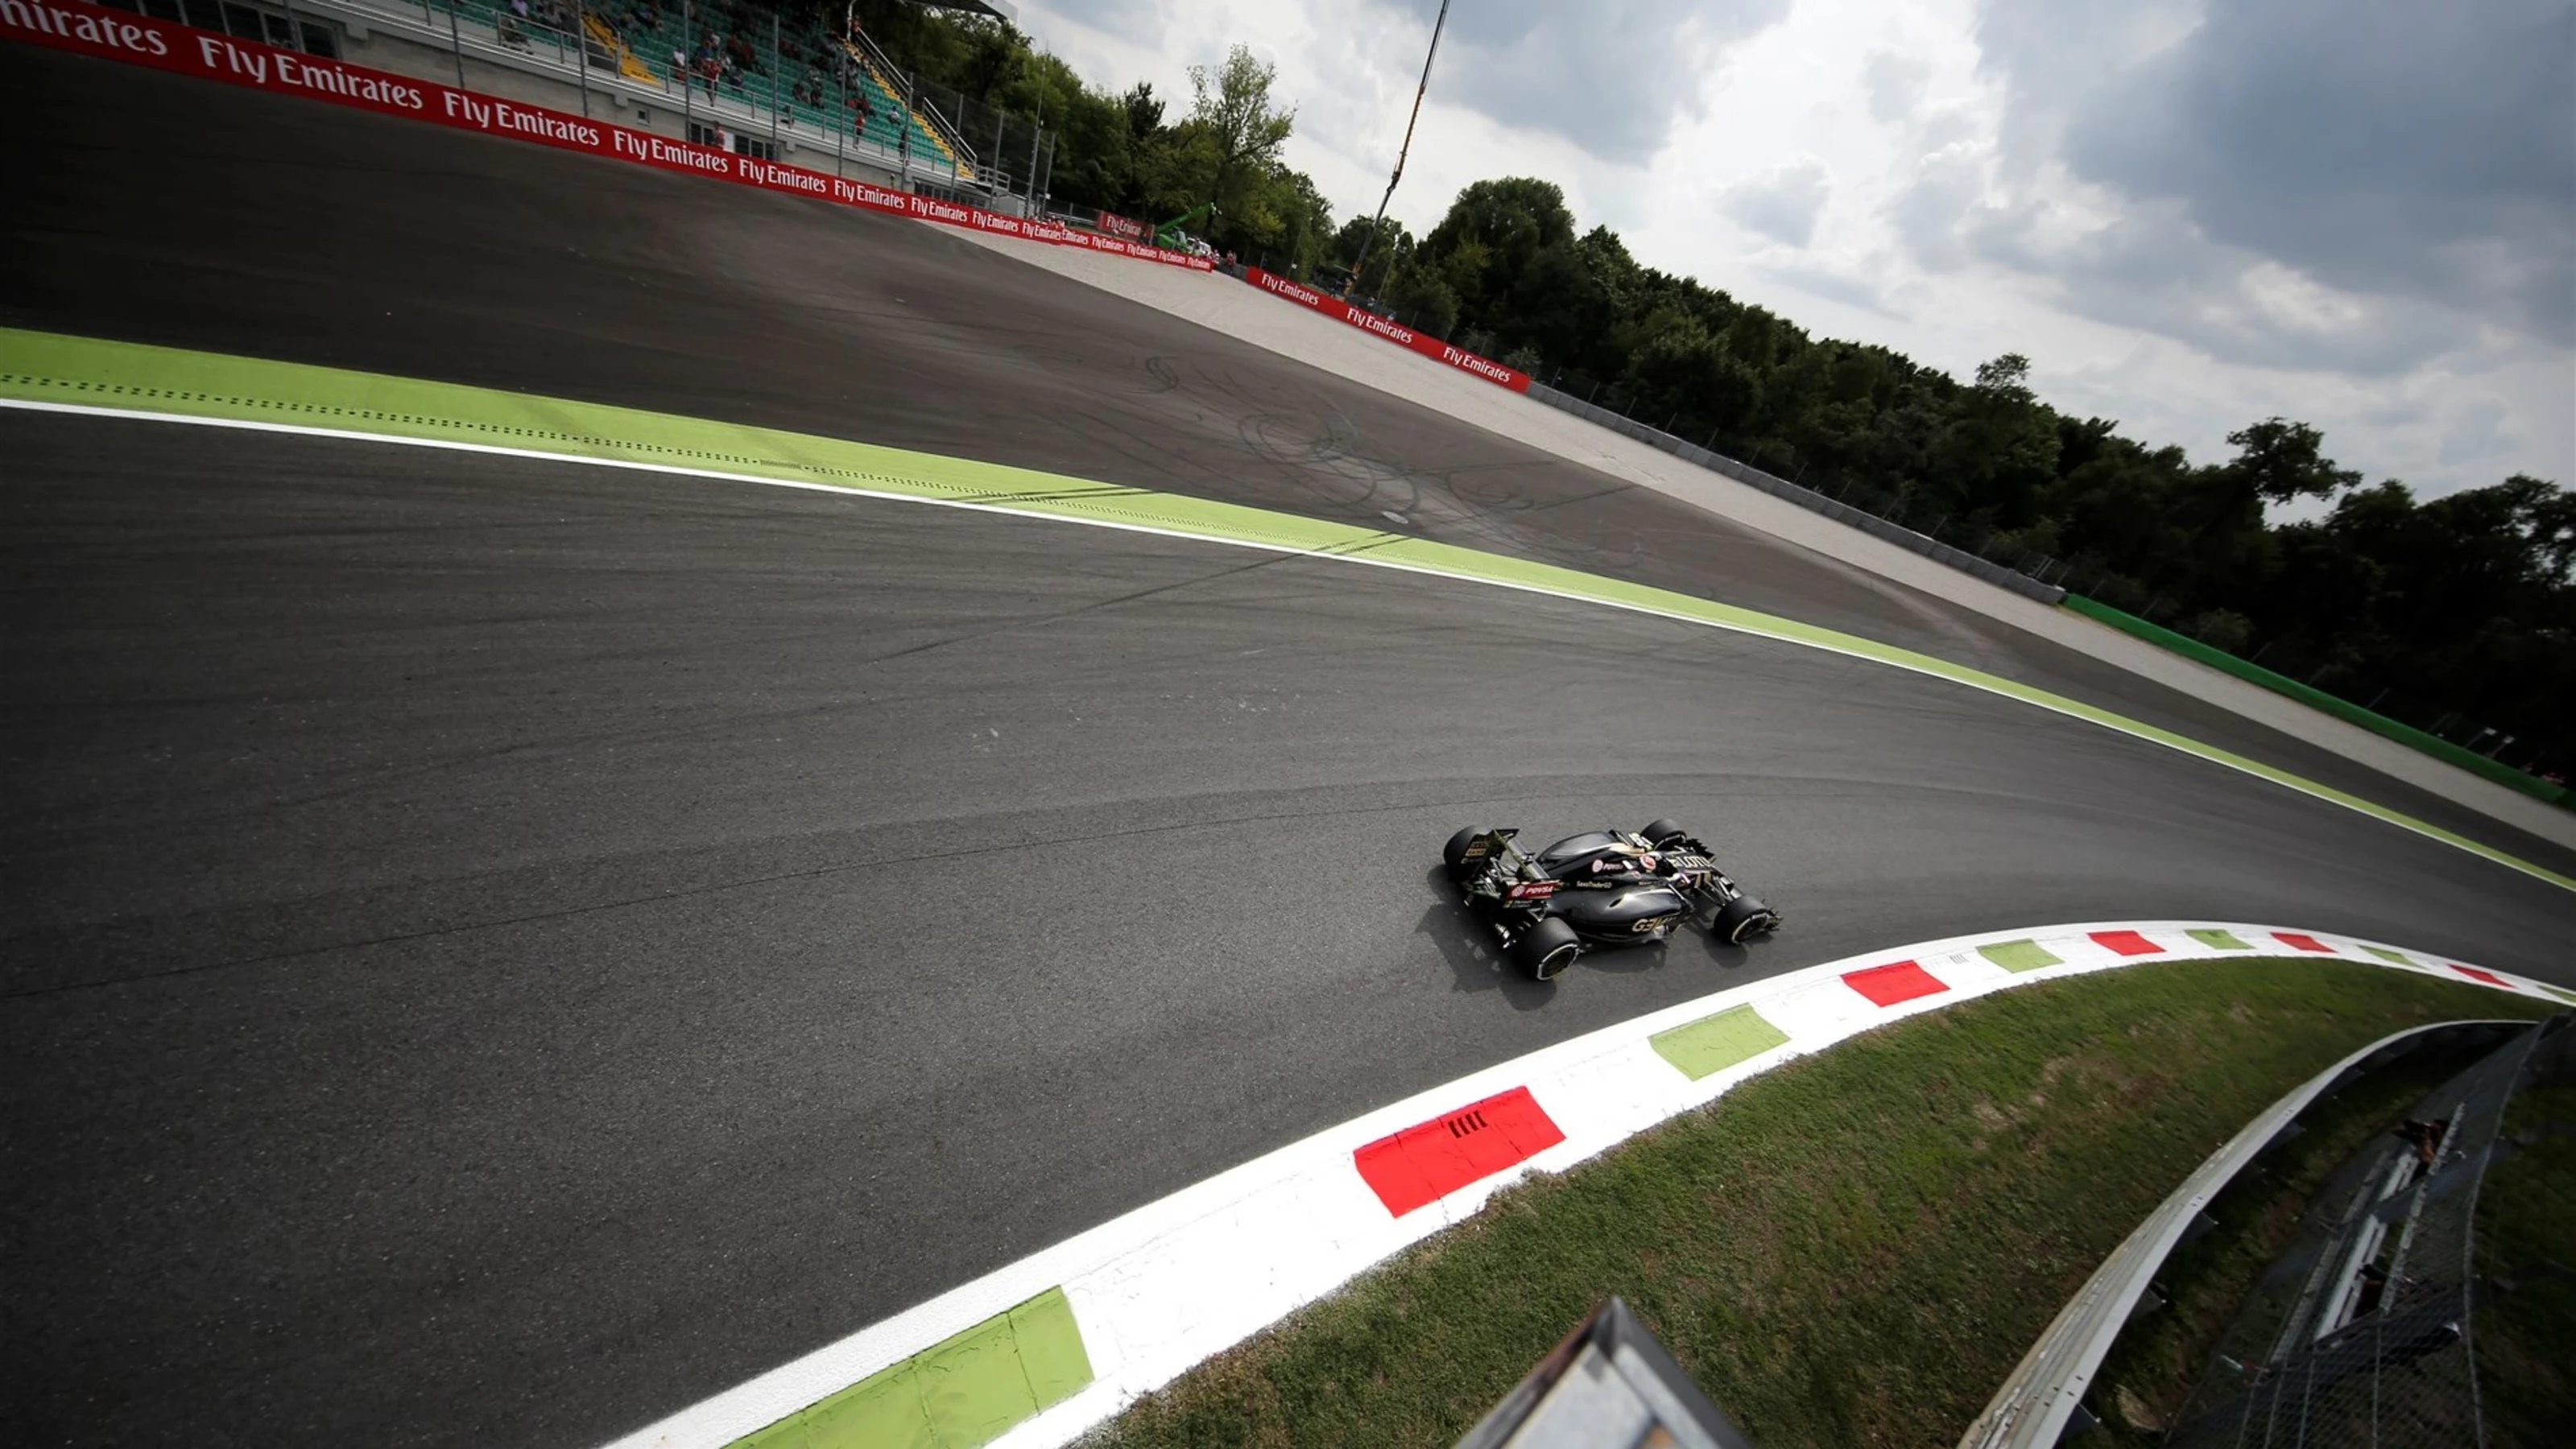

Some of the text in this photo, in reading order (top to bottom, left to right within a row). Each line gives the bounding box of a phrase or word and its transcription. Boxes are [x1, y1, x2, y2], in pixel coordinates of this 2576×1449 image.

[197, 35, 423, 109] Fly Emirates
[444, 91, 599, 146] Fly Emirates
[614, 130, 728, 172] Fly Emirates
[738, 159, 826, 192] Fly Emirates
[834, 179, 904, 209] Fly Emirates
[911, 197, 968, 221] Fly Emirates
[973, 211, 1019, 232] Fly Emirates
[1022, 222, 1061, 241] Fly Emirates
[1262, 273, 1319, 306] Fly Emirates
[1346, 308, 1412, 344] Fly Emirates
[1443, 346, 1511, 382] Fly Emirates
